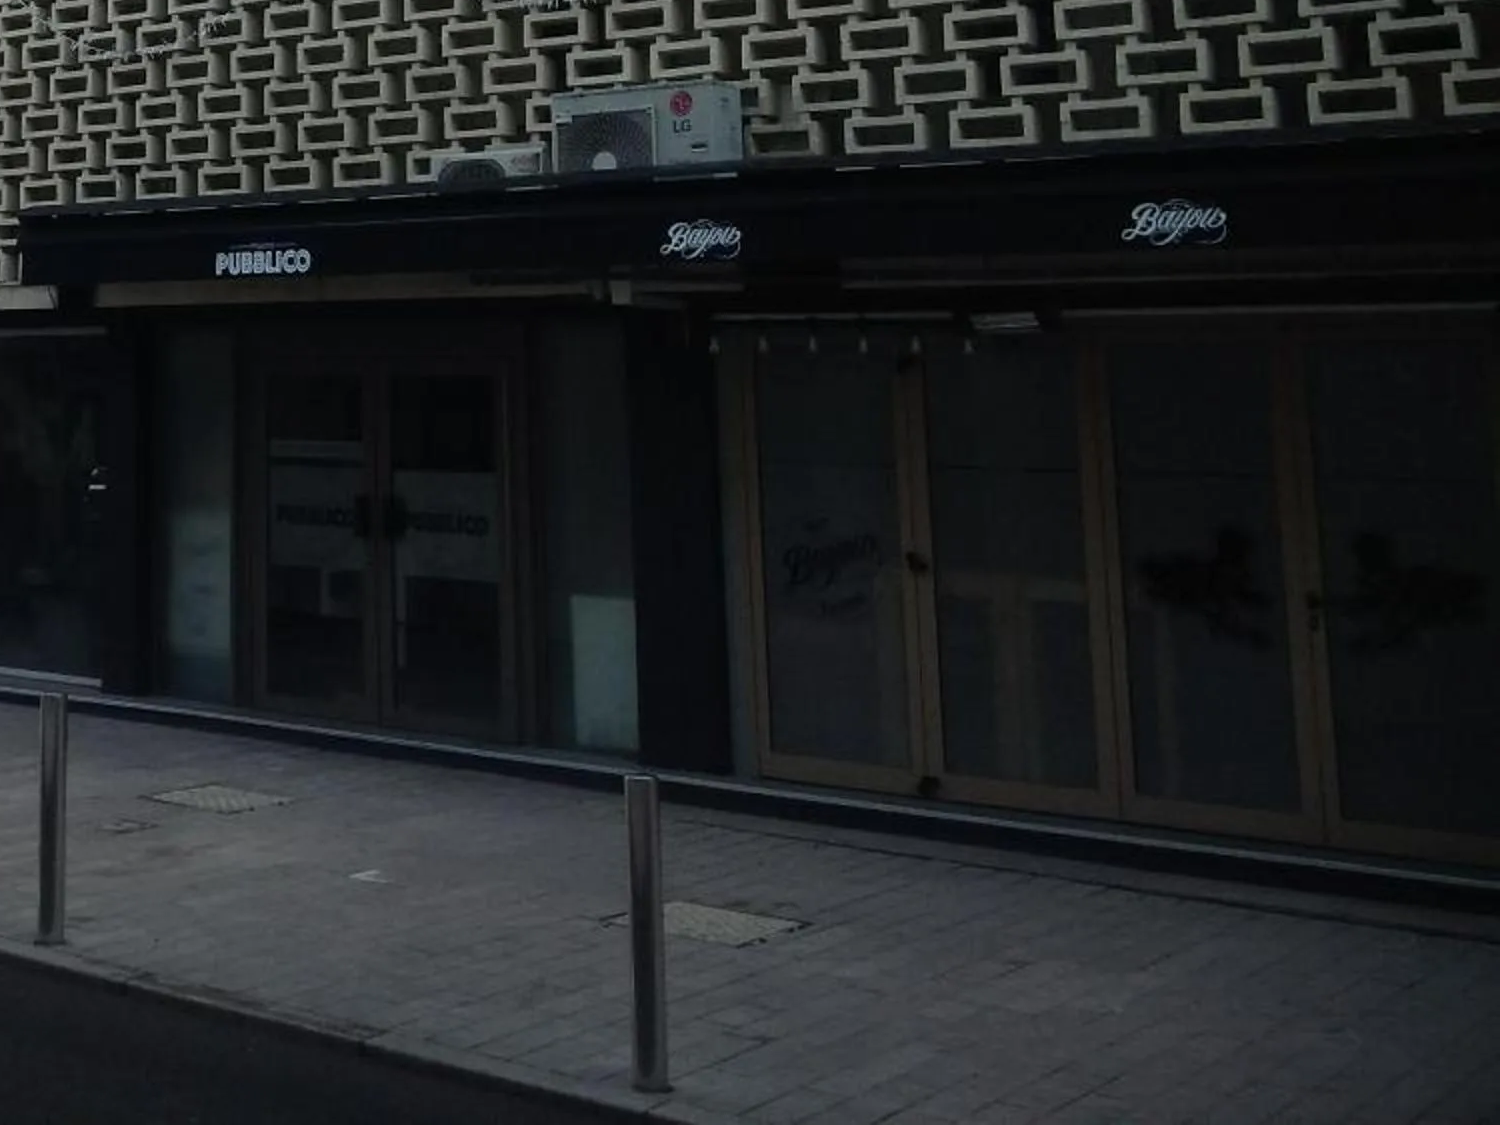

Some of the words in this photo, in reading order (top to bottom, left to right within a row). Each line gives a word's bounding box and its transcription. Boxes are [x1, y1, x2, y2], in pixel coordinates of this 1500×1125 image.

[673, 118, 692, 134] LG
[659, 220, 741, 260] Bayou
[1121, 200, 1229, 246] Bayou
[215, 248, 311, 276] PUBBLICO
